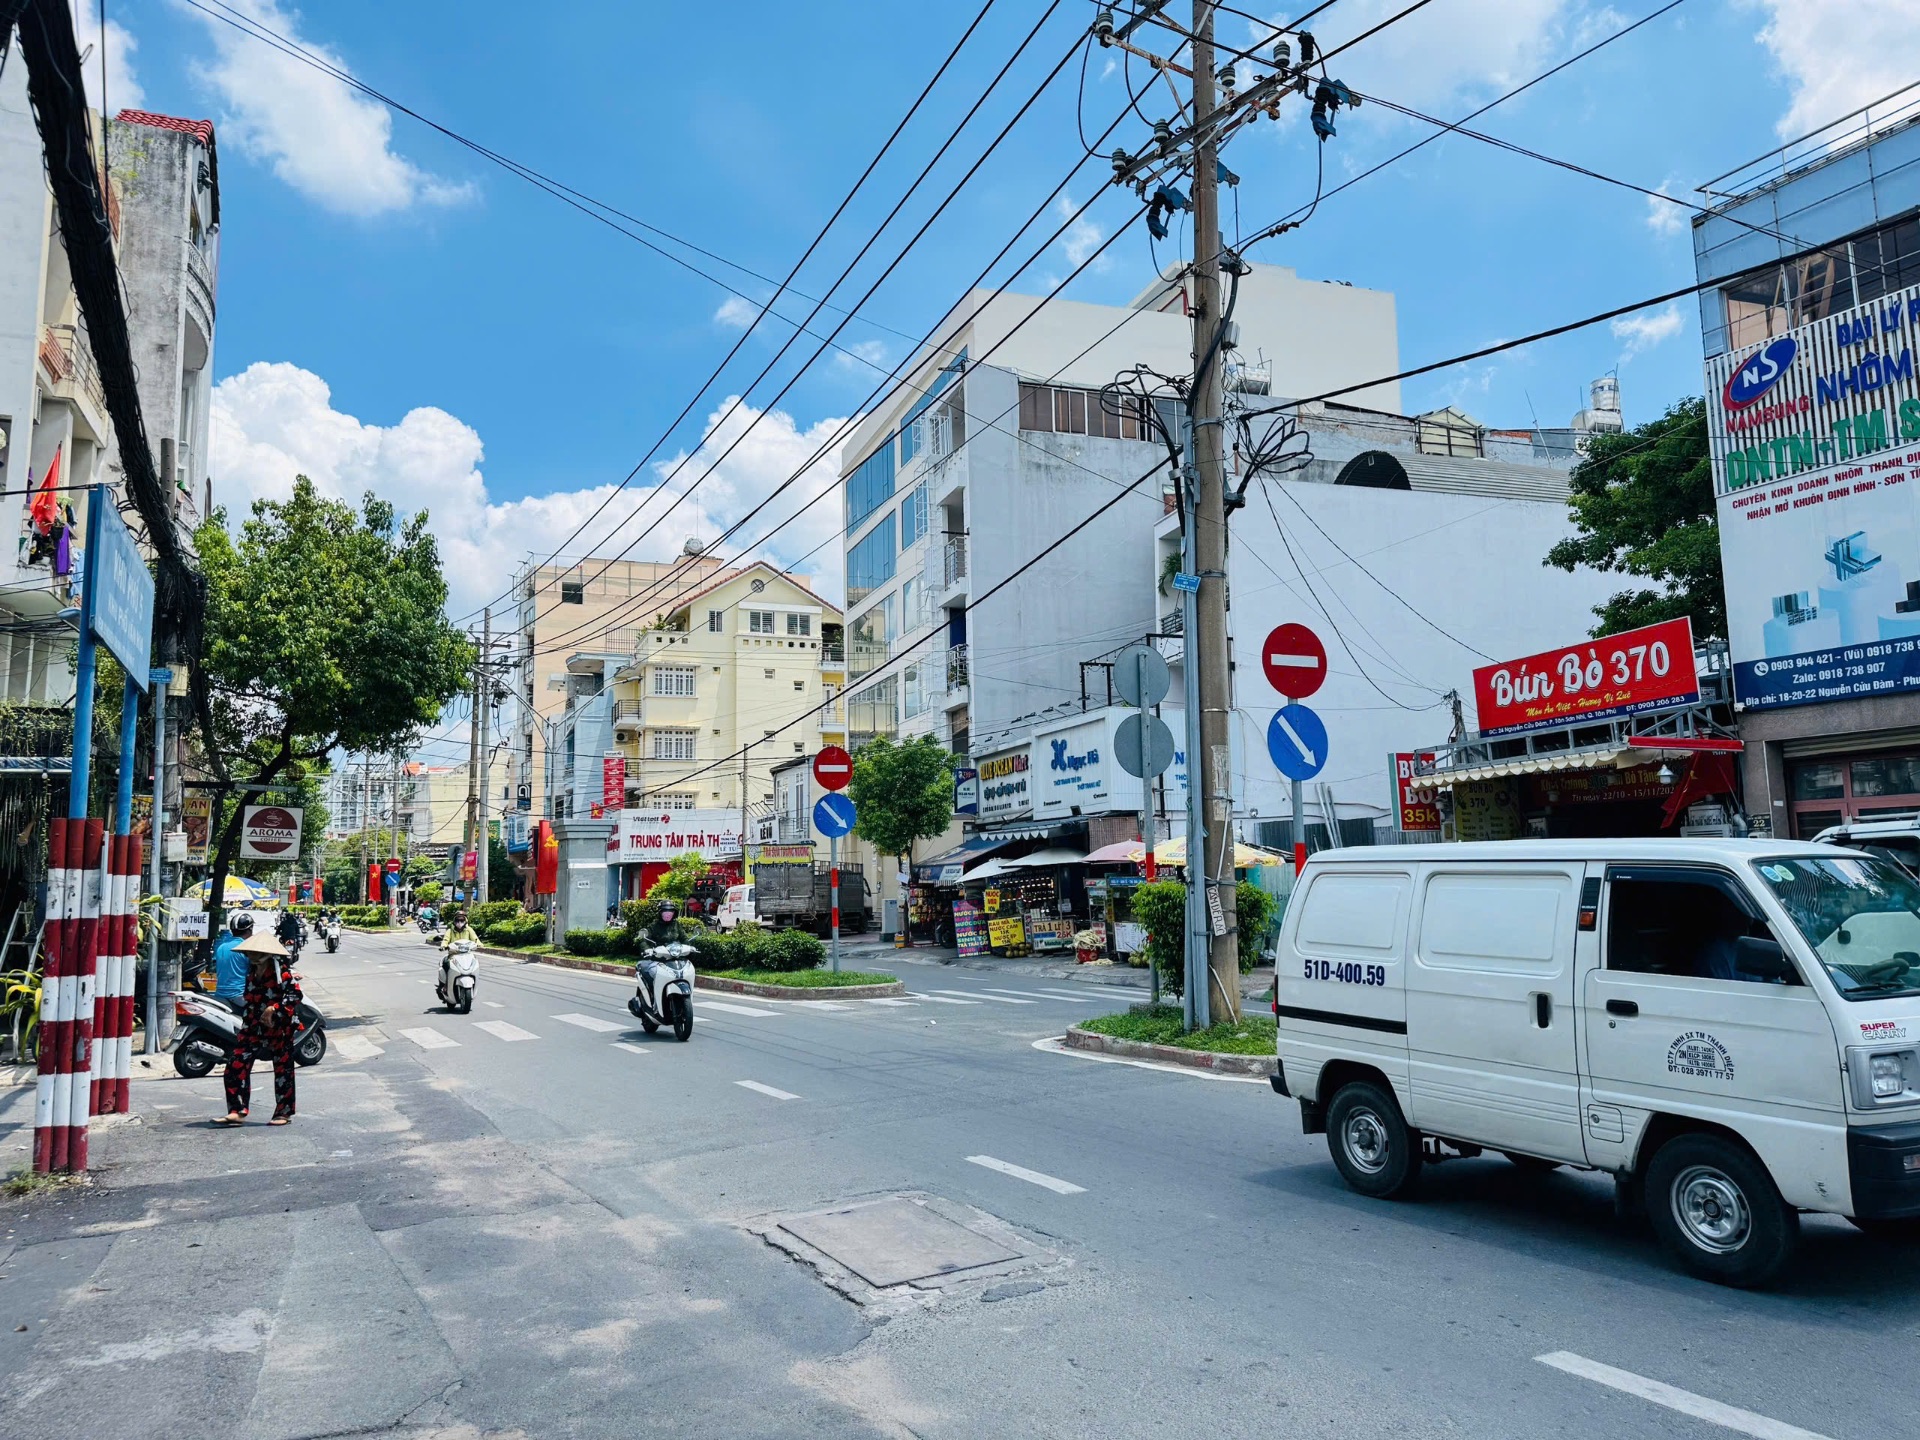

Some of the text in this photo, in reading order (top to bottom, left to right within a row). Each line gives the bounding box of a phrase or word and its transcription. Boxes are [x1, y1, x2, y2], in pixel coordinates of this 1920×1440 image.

[1837, 315, 1872, 347] ĐẠI
[1880, 300, 1902, 332] LÝ
[1742, 343, 1778, 388] NS
[1817, 348, 1913, 406] NHÔM
[1726, 395, 1810, 433] NAMSUNG
[1732, 492, 1766, 510] CHUYÊN
[1771, 486, 1793, 499] KINH
[1797, 476, 1829, 492] DOANH
[1834, 466, 1864, 482] NHÔM
[1868, 456, 1903, 473] THANH
[1746, 507, 1771, 520] NHẬN
[1793, 492, 1824, 509] KHUÔN
[1828, 487, 1850, 502] ĐỊNH
[1854, 479, 1876, 494] HÌNH
[1884, 472, 1905, 486] SƠN
[1771, 659, 1794, 672] 0903
[1796, 656, 1814, 668] 944
[1816, 653, 1833, 664] 421
[1867, 644, 1892, 658] 0918
[1894, 640, 1914, 653] 738
[1490, 641, 1670, 707] Bún Bò 370
[1792, 662, 1886, 684] Zalo: 0918 738 907
[1746, 696, 1759, 708] Địa
[1778, 690, 1816, 702] 18-20-22
[1818, 682, 1851, 698] Nguyễn
[1873, 678, 1894, 690] Đàm
[1504, 724, 1523, 733] Nguyễn
[1671, 696, 1685, 704] 283
[1404, 808, 1436, 822] 35k
[250, 828, 293, 837] AROMA
[630, 834, 662, 848] TRUNG
[665, 832, 684, 848] TÂM
[687, 830, 704, 848] TRẢ
[190, 913, 206, 924] THUÊ
[1034, 923, 1046, 932] TRÀ
[1304, 959, 1386, 986] 51D-400.59
[1860, 1022, 1896, 1030] SUPER
[1862, 1028, 1906, 1040] CARRY
[1670, 1035, 1685, 1050] TNHH
[1708, 1034, 1727, 1055] THANH
[1668, 1064, 1734, 1080] ĐT: 028 3971 77 57
